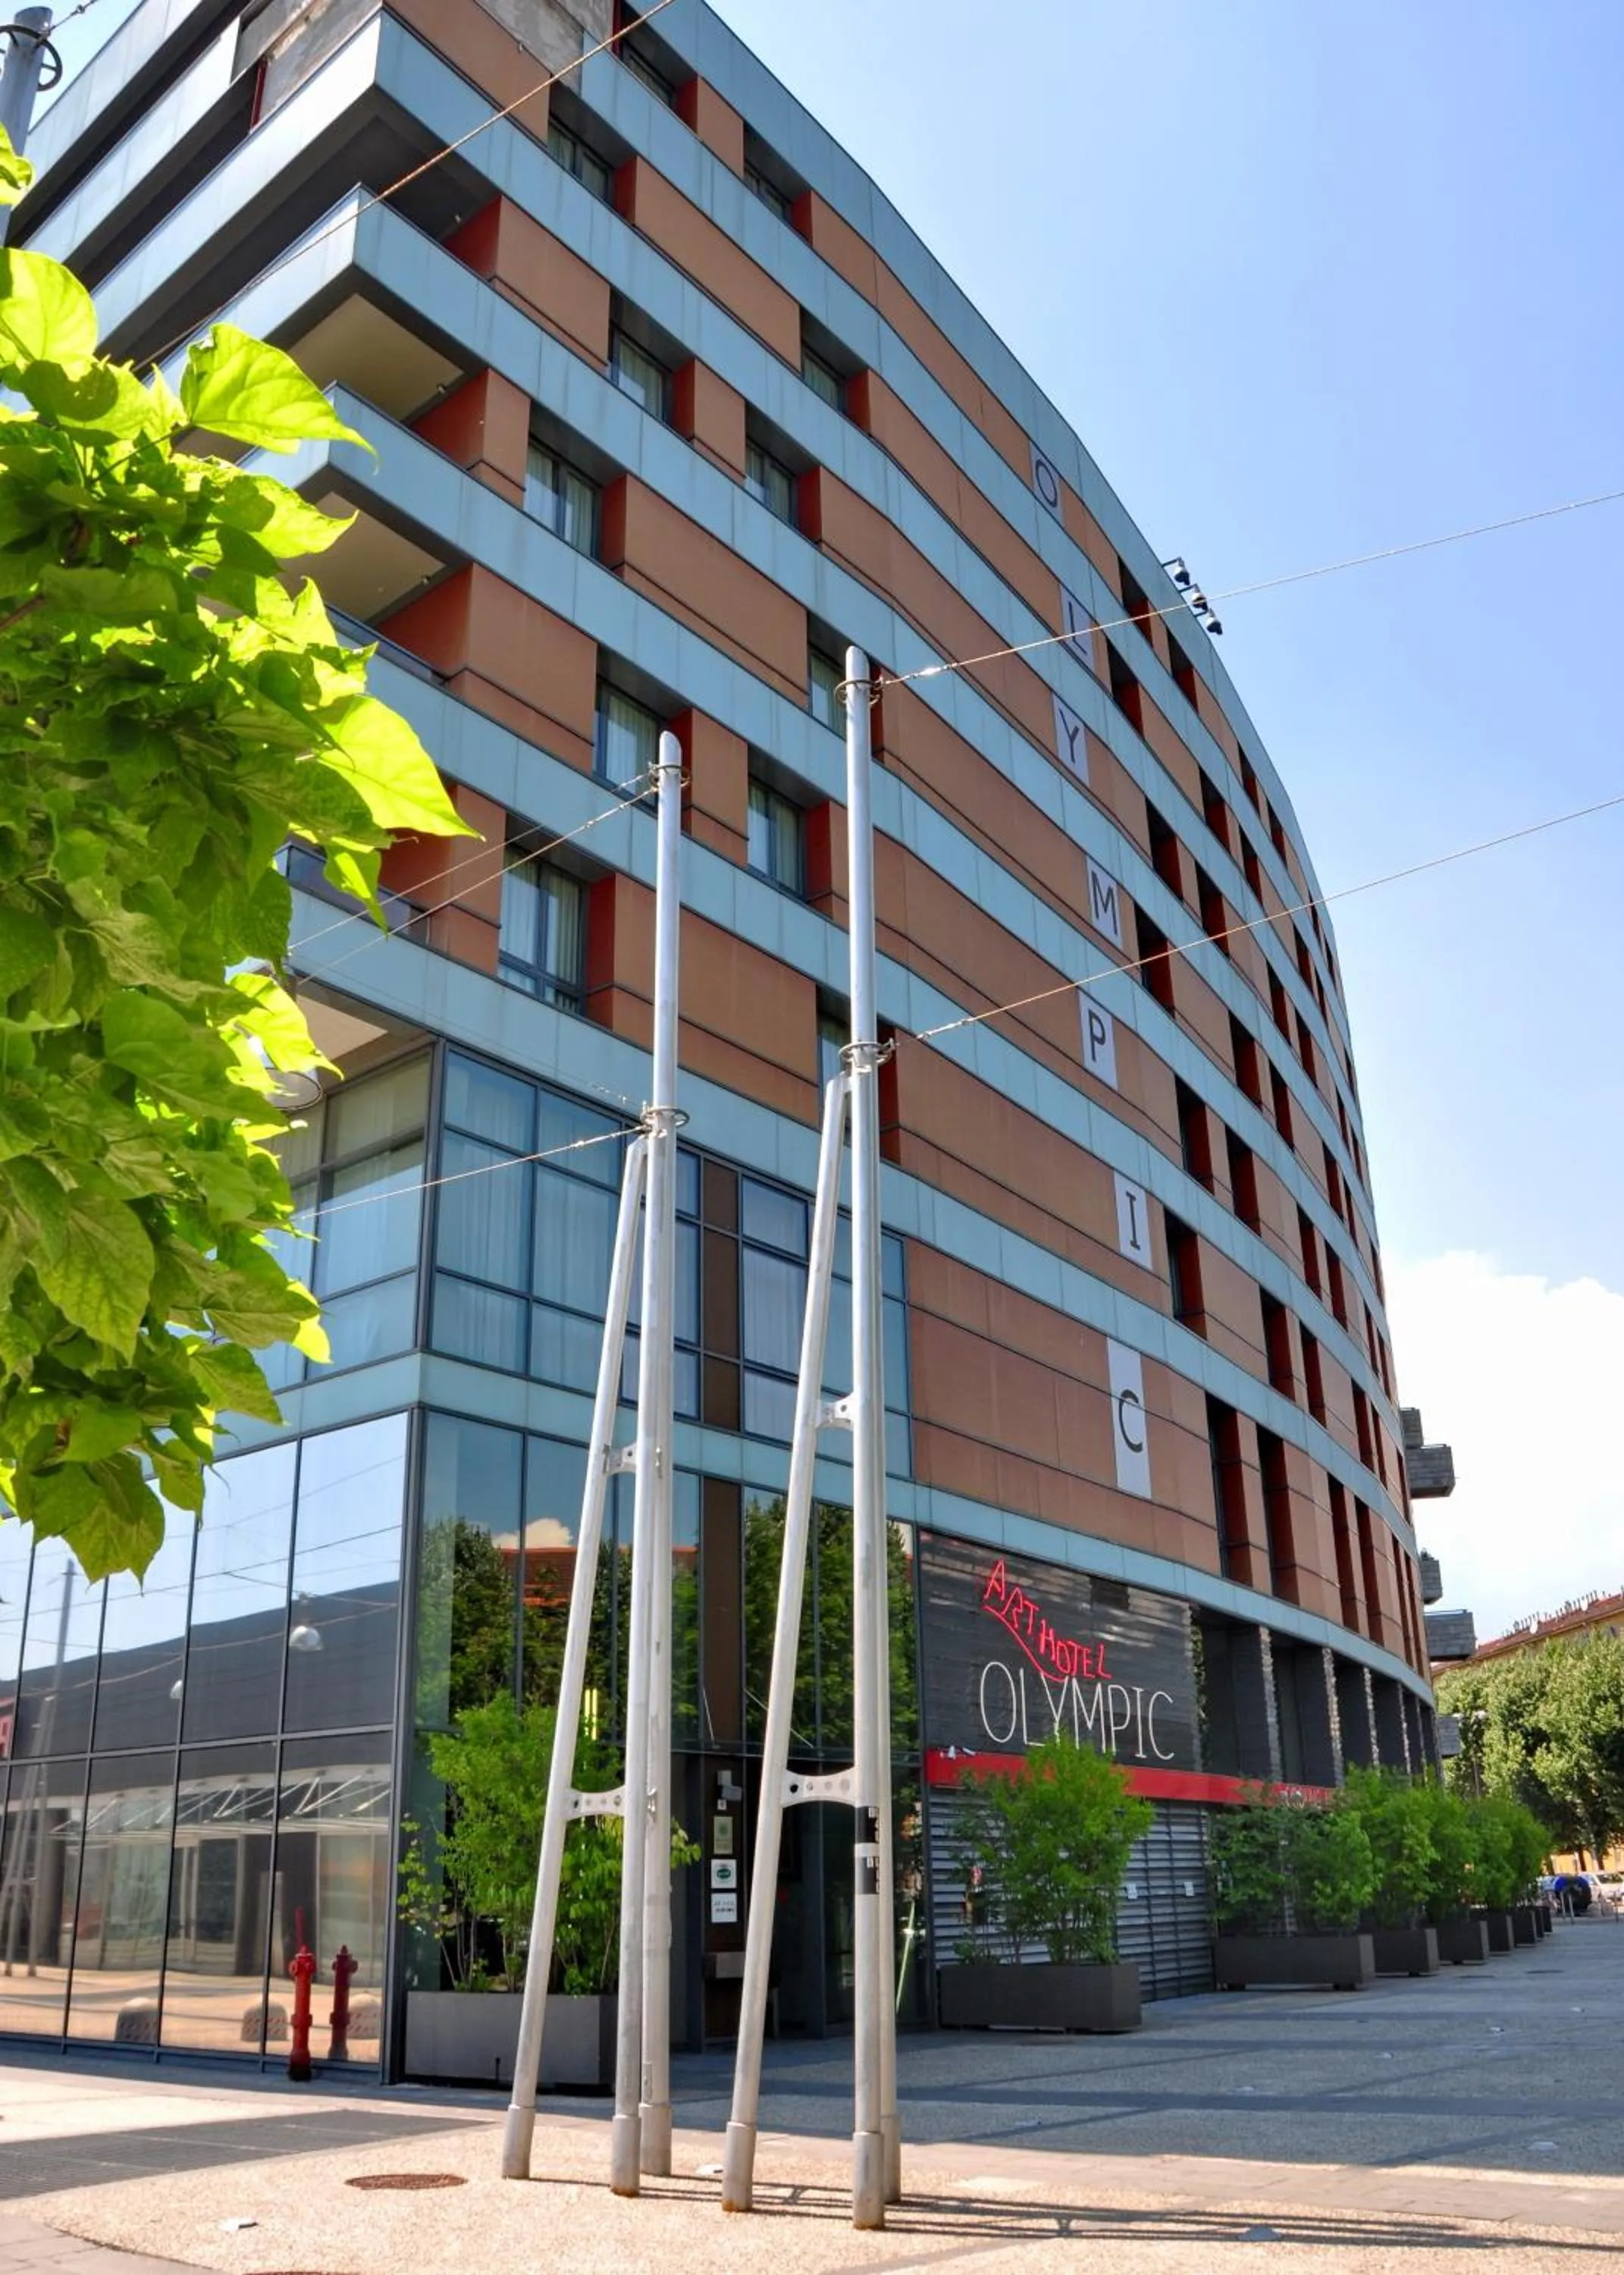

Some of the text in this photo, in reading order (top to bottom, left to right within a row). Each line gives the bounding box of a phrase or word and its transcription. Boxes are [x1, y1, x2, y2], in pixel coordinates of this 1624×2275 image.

[1034, 458, 1144, 1454] OLYMPIC
[983, 1558, 1113, 1679] ART HOTEL
[980, 1661, 1175, 1760] OLYMPIC
